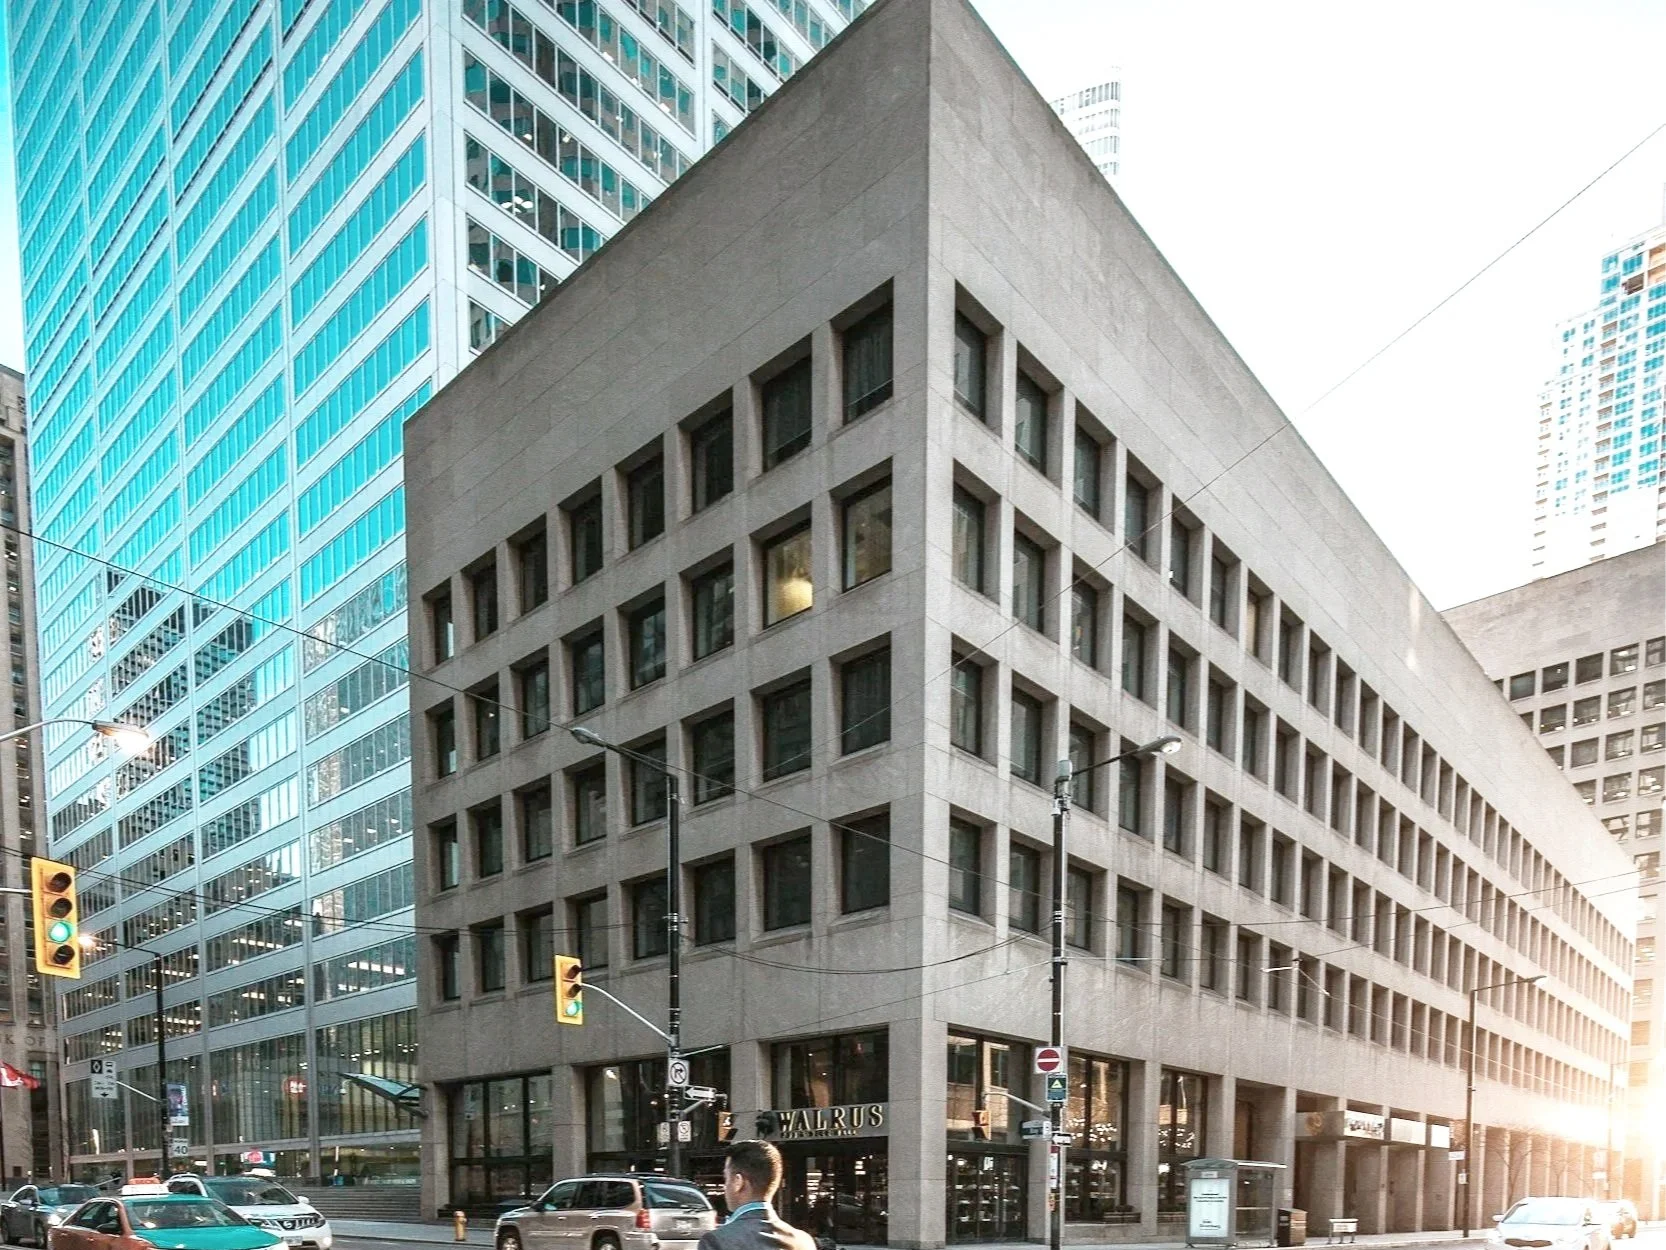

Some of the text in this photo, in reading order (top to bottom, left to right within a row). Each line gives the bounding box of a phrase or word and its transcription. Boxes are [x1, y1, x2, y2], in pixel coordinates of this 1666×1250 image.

[24, 1035, 46, 1047] OF
[778, 1104, 884, 1132] WALRUS
[173, 1145, 188, 1155] 40
